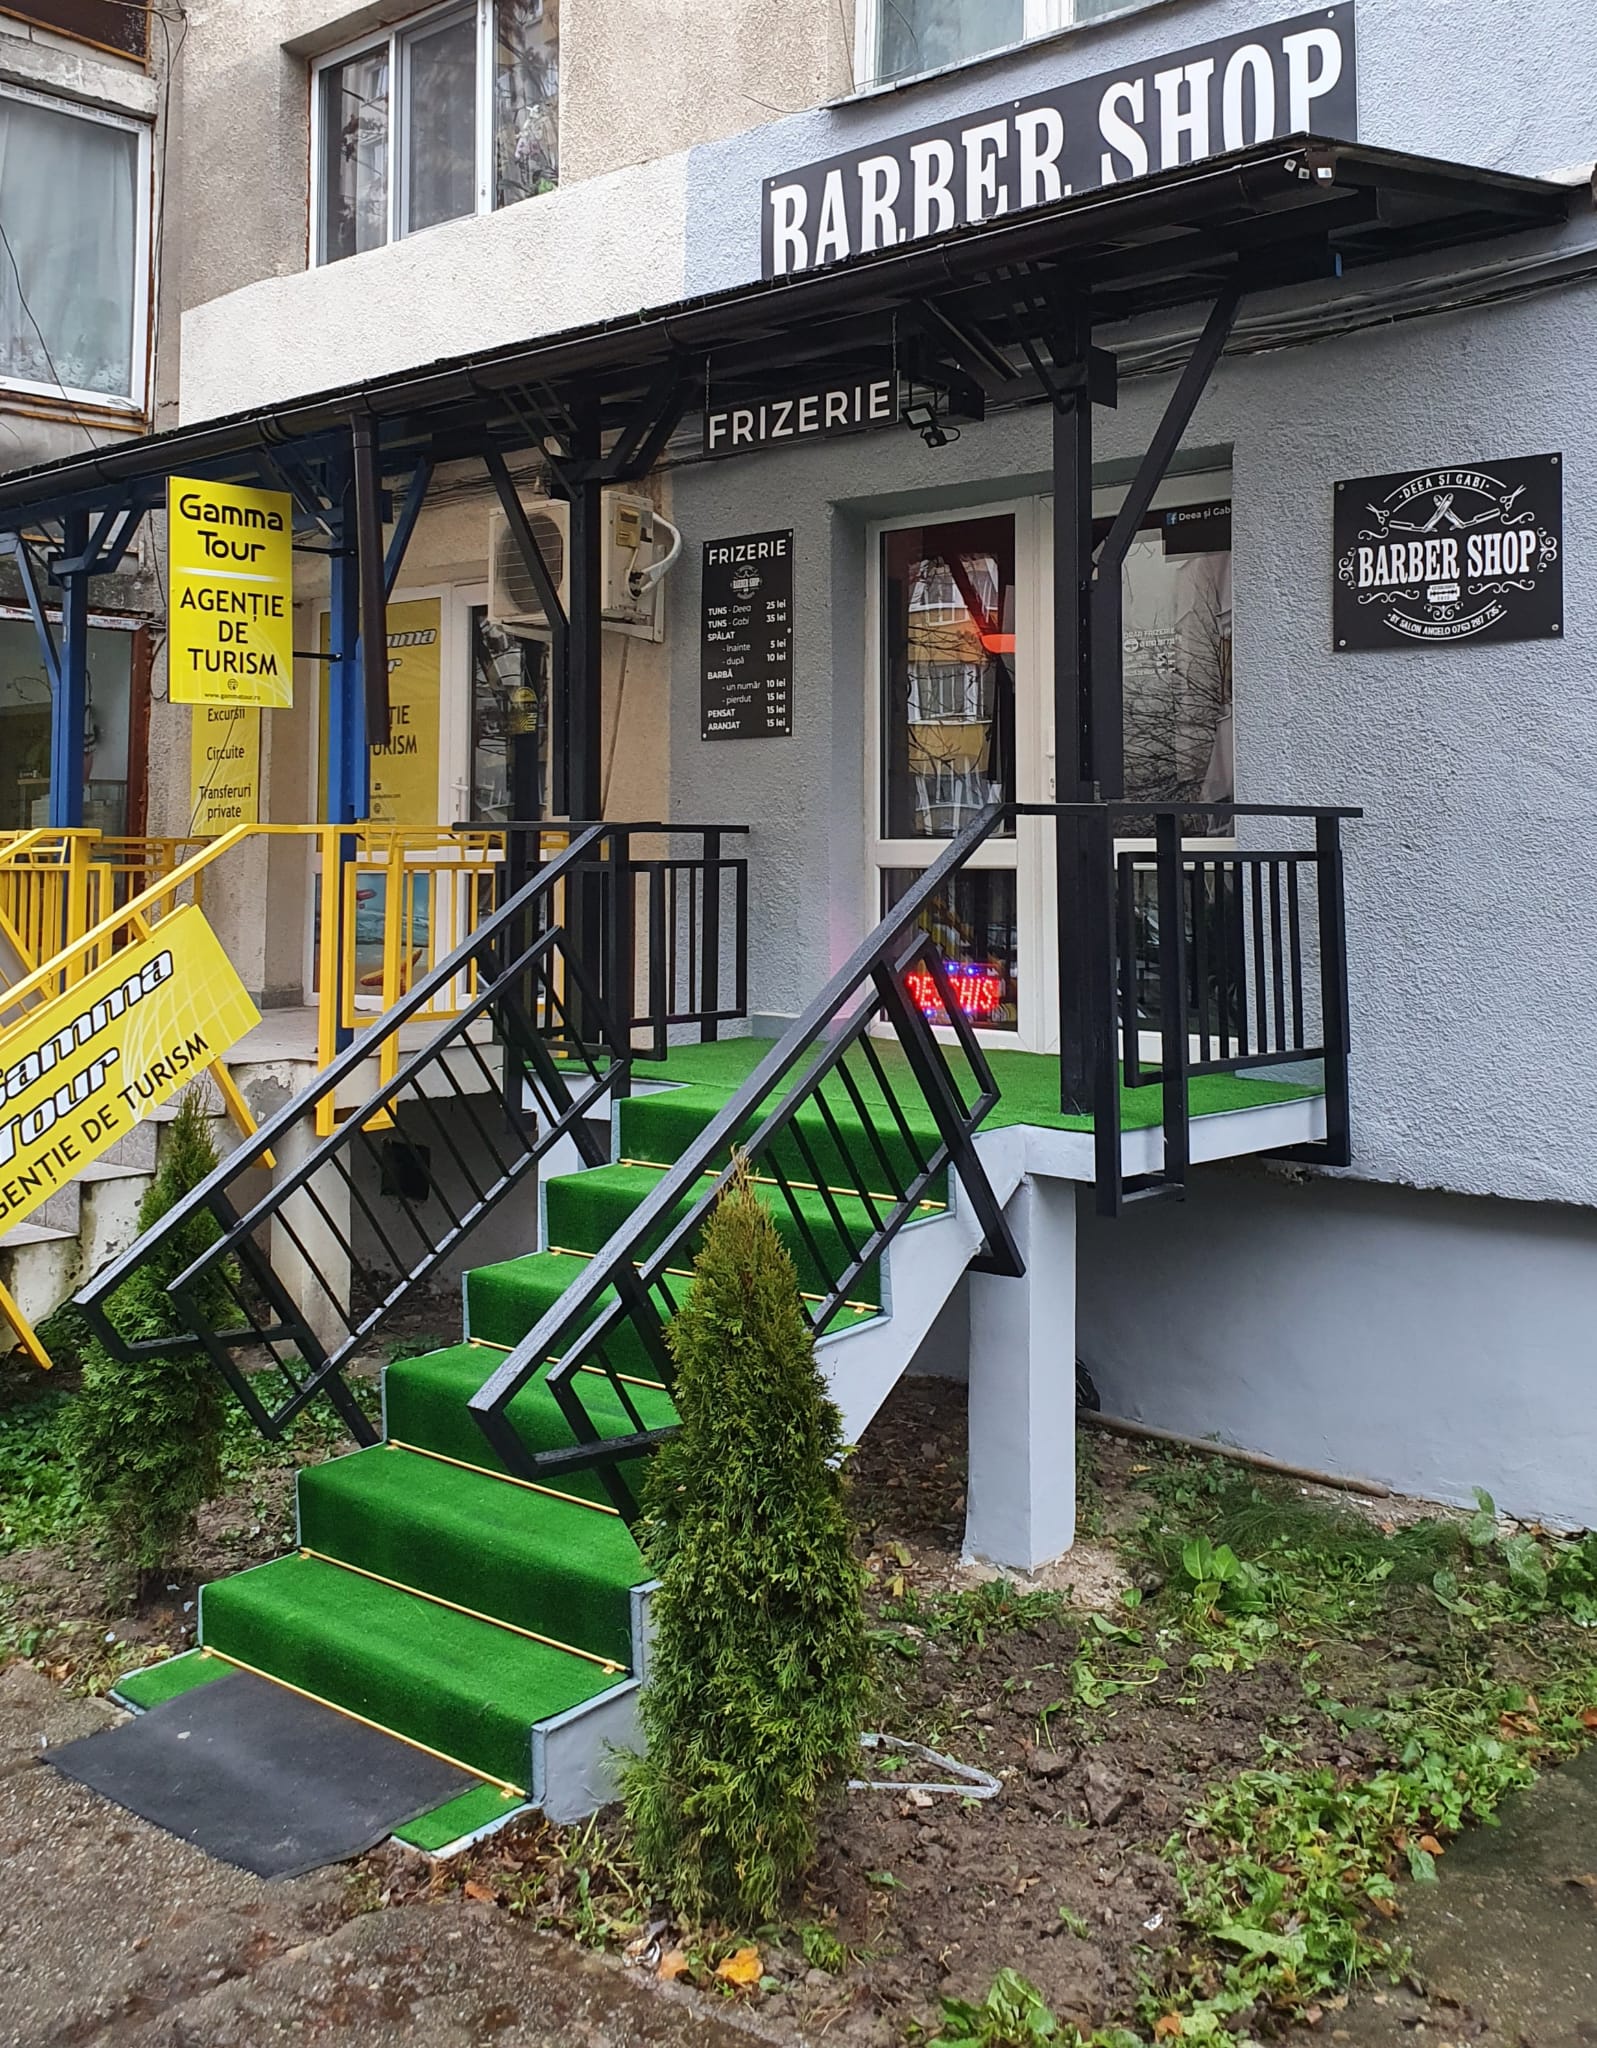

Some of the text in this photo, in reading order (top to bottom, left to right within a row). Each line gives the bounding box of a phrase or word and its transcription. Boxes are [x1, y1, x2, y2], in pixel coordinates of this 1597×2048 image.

[770, 27, 1343, 276] BARBER SHOP
[709, 380, 890, 449] FRIZERIE
[1402, 477, 1433, 499] DEEA
[1455, 473, 1486, 490] GABI
[179, 493, 284, 531] Gamma
[1179, 512, 1202, 521] Deea
[197, 530, 266, 562] Tour
[708, 539, 786, 566] FRIZERIE
[1358, 530, 1537, 588] BARBER SHOP
[180, 586, 284, 622] AGENȚIE
[708, 606, 727, 616] TUNS
[732, 604, 752, 614] Deea
[766, 600, 776, 610] 25
[776, 599, 786, 608] lei
[708, 619, 727, 629] TUNS
[732, 616, 750, 626] Gabi
[766, 613, 776, 623] 35
[776, 612, 786, 621] lei
[1400, 619, 1422, 634] SALON
[1422, 626, 1451, 635] ANGELO
[218, 620, 248, 644] DE
[770, 640, 776, 649] 5
[776, 638, 786, 647] lei
[187, 647, 278, 676] TURISM
[766, 653, 775, 662] 10
[776, 651, 786, 661] lei
[766, 679, 775, 688] 10
[776, 678, 786, 687] lei
[726, 695, 752, 706] pierdut
[766, 692, 775, 701] 15
[776, 691, 786, 700] lei
[707, 704, 786, 718] PENSAT 15 lei
[707, 717, 786, 731] ARANJAT 15 lei
[206, 745, 245, 761] Circuite
[198, 783, 252, 800] Transferuri
[207, 804, 242, 822] private
[80, 1103, 119, 1144] DE
[116, 1031, 210, 1110] TURISM
[0, 1046, 119, 1169] Tour
